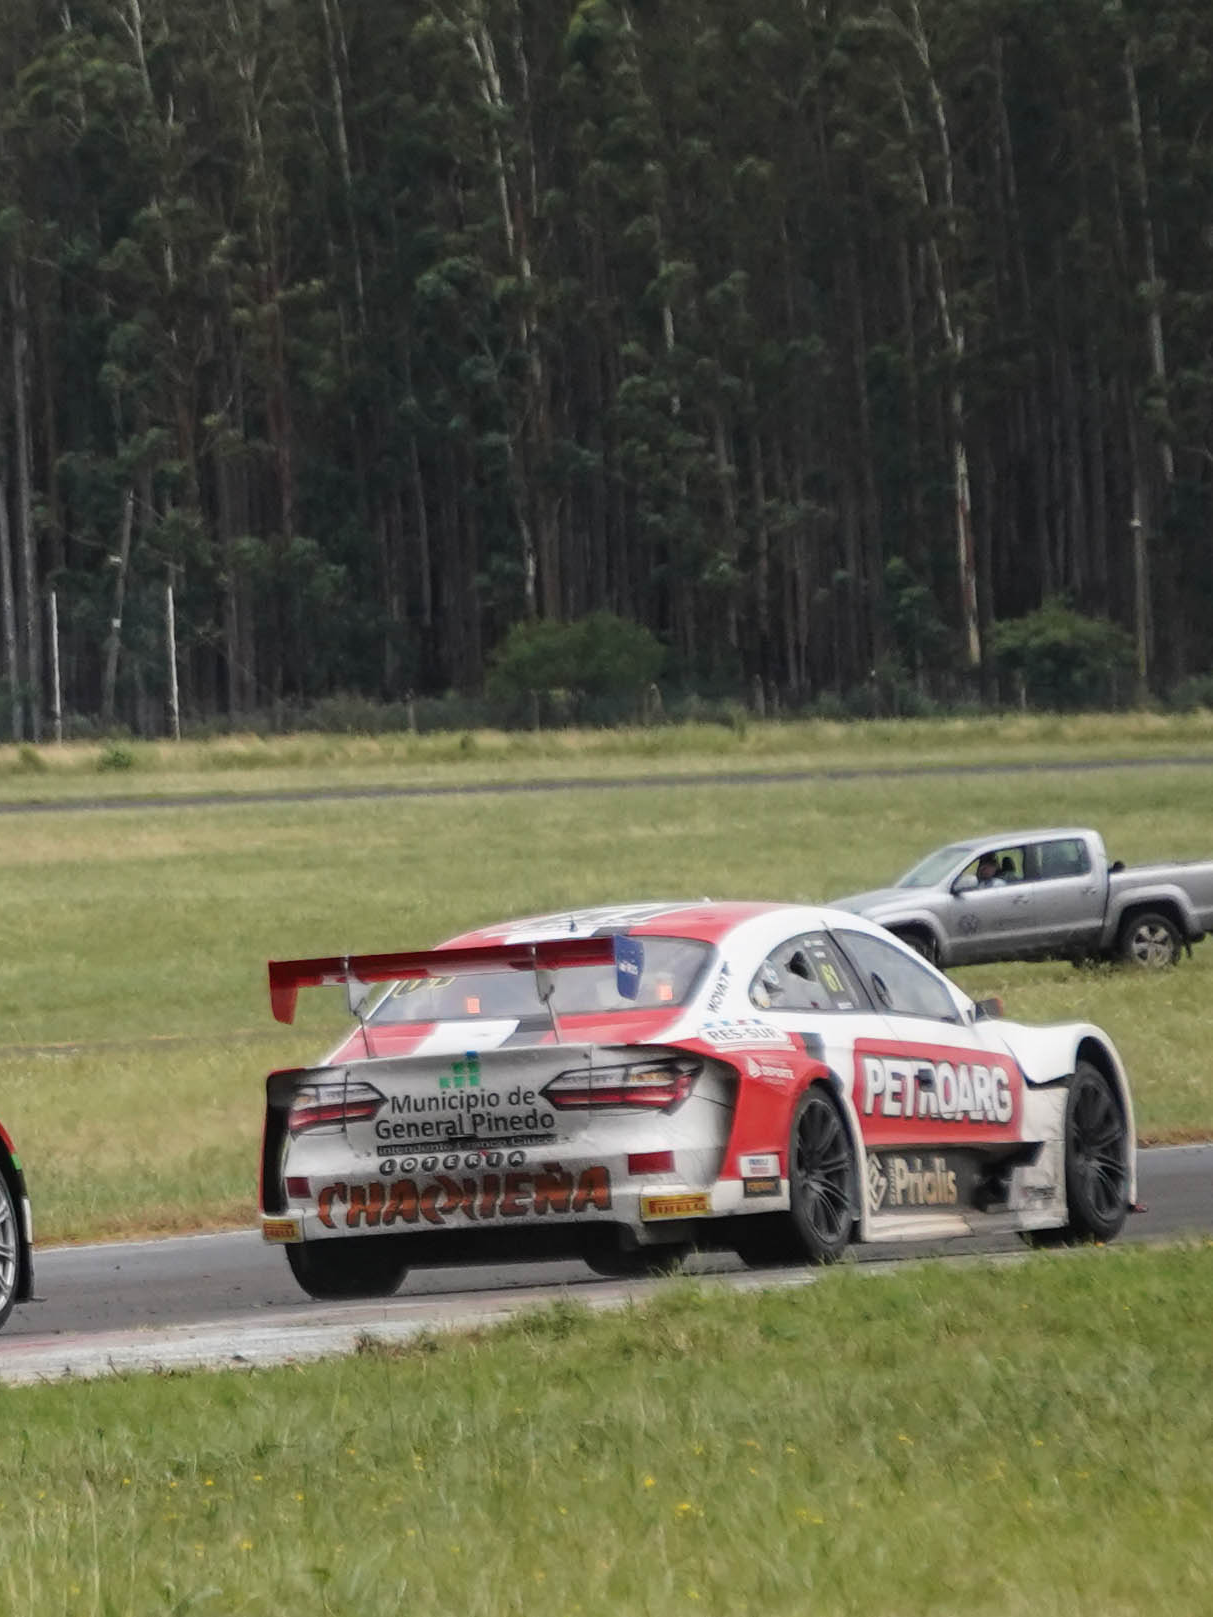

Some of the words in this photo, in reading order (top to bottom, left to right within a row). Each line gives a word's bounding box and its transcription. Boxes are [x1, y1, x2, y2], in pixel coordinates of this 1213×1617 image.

[391, 1089, 500, 1114] Municipio
[508, 1086, 535, 1106] de
[863, 1056, 1013, 1124] PETROARG
[375, 1114, 464, 1140] General
[472, 1109, 555, 1134] Pinedo
[380, 1150, 525, 1176] LOTERIA
[318, 1161, 612, 1229] CHAQUEÑA
